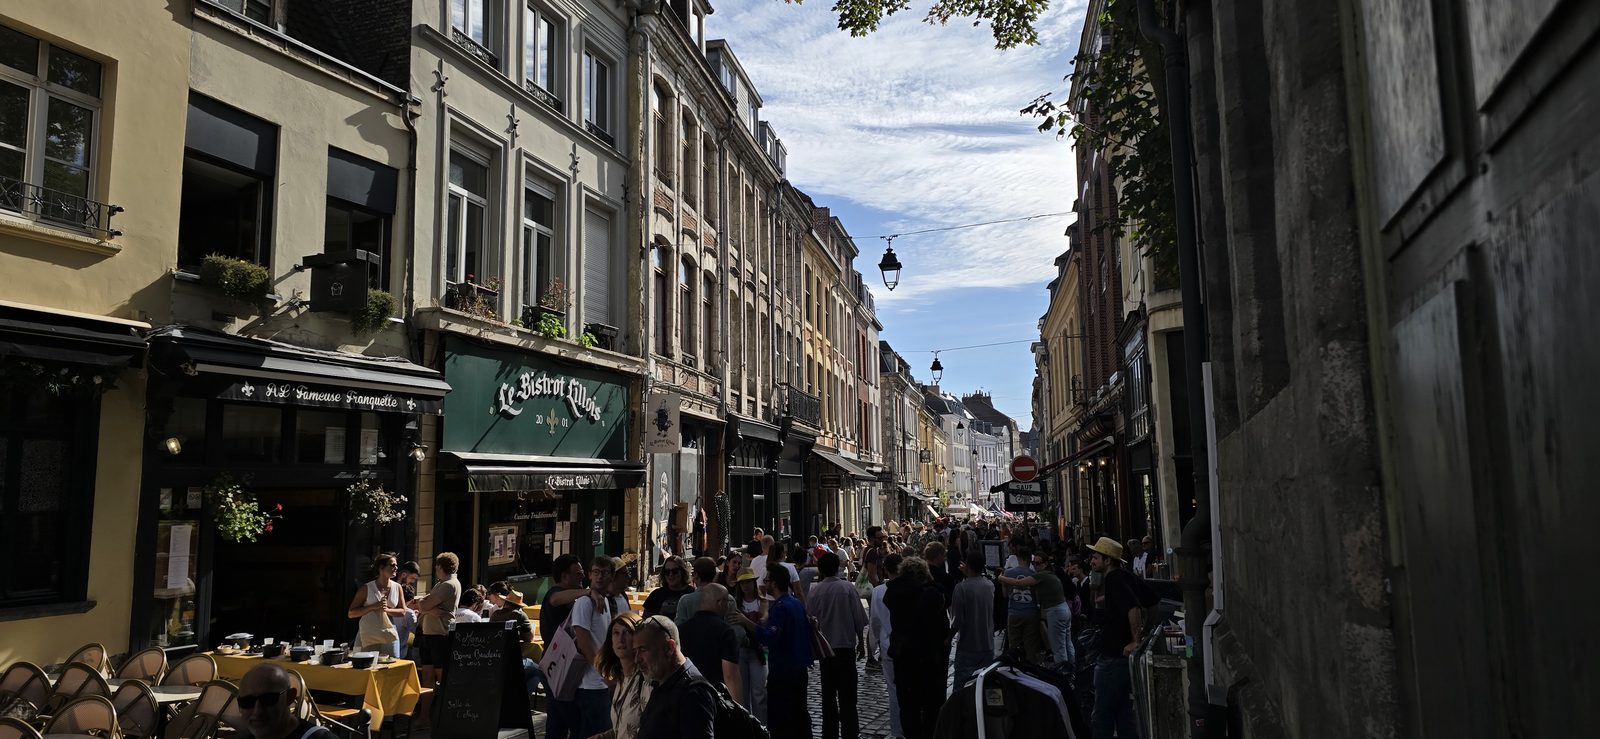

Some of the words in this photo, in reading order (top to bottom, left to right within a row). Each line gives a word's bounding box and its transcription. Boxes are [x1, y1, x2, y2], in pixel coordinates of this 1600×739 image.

[346, 390, 399, 410] Franquette
[499, 382, 523, 416] Le
[516, 371, 566, 400] Bistrot
[566, 378, 602, 421] Lillois
[535, 414, 544, 425] 20
[561, 417, 569, 427] 01
